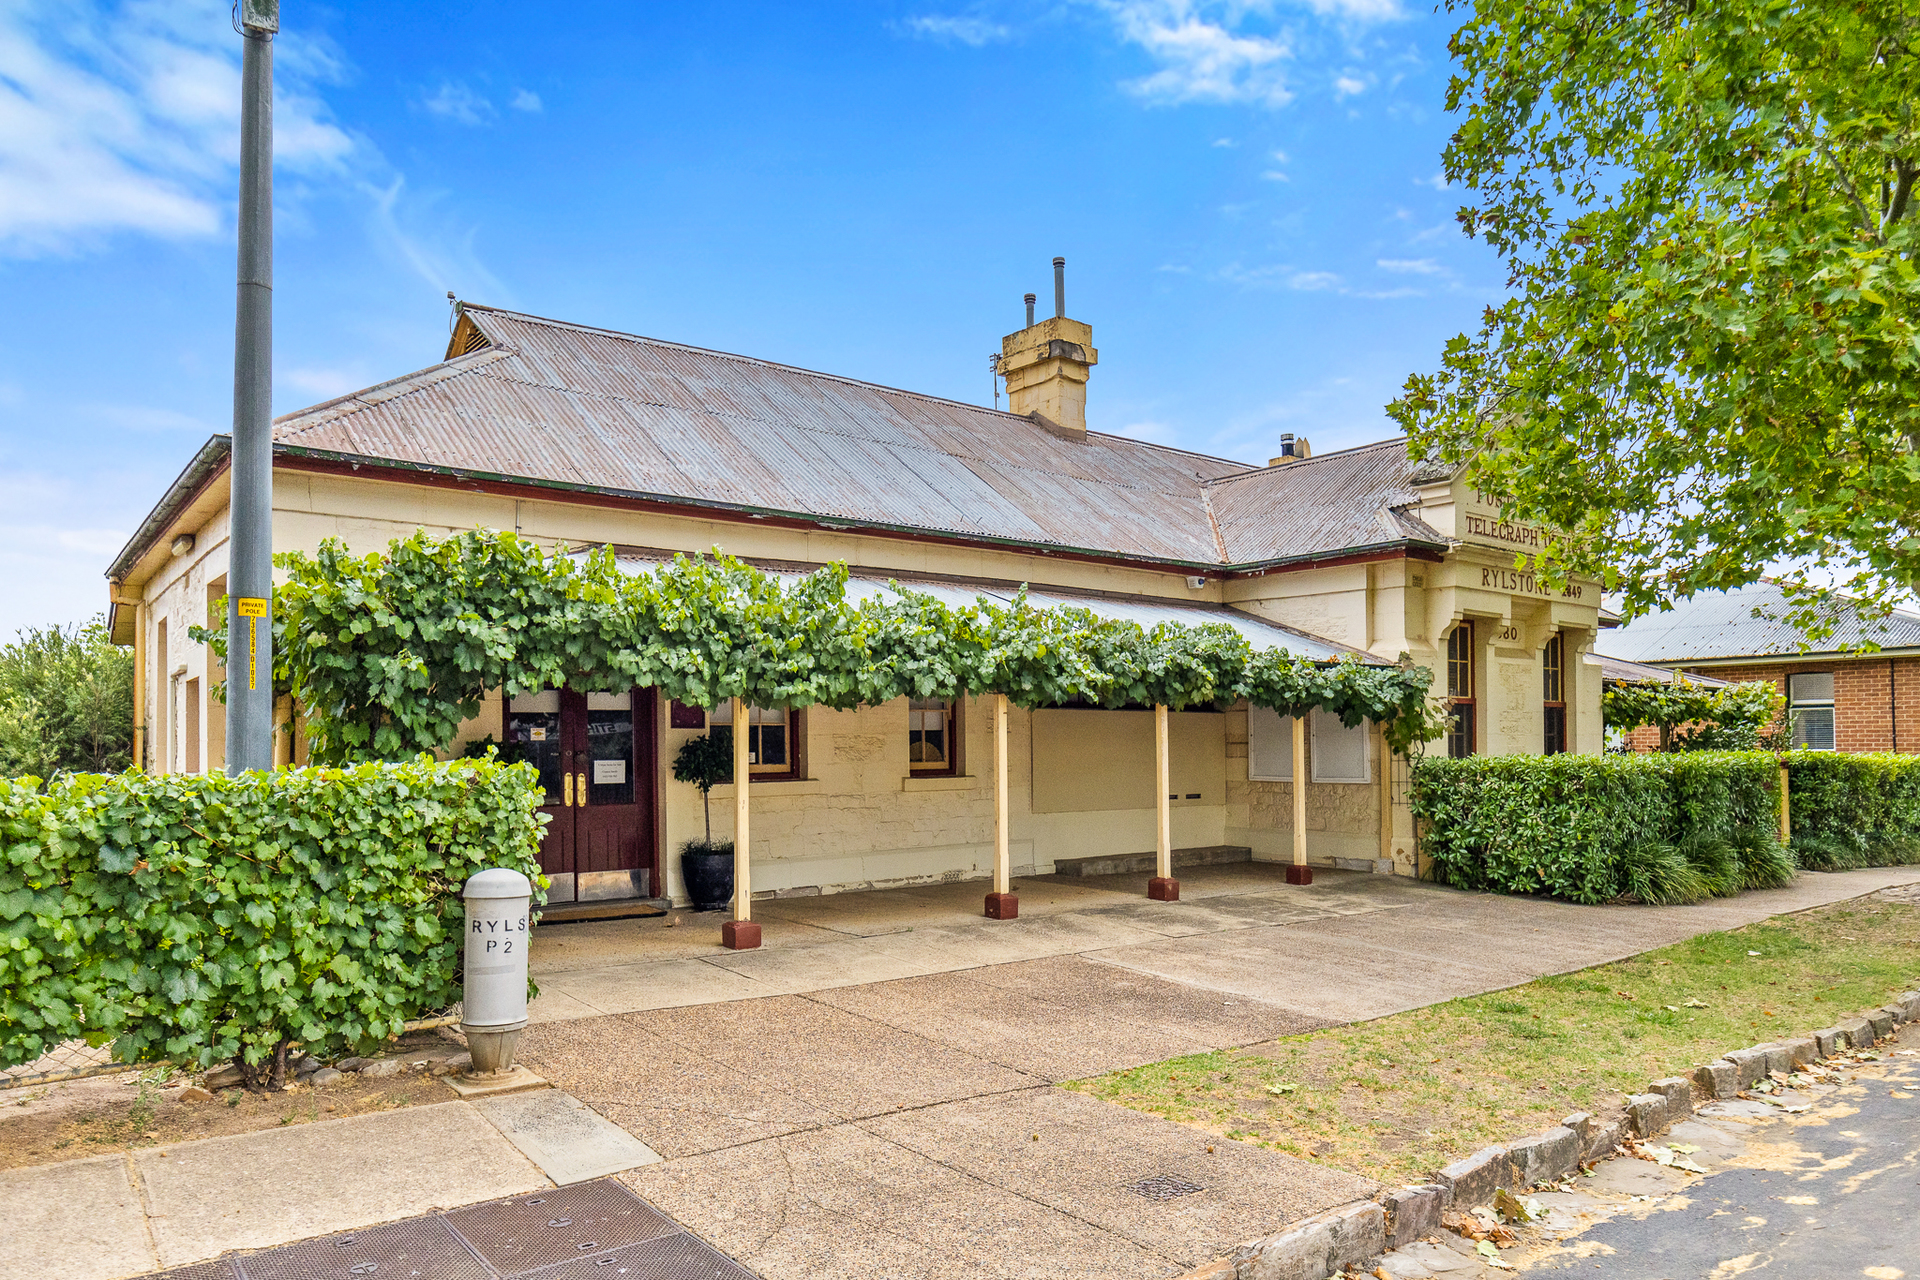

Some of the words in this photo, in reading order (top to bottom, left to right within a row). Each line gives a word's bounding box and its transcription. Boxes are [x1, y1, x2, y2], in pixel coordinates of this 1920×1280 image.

[1465, 515, 1539, 547] TELEGRAPH
[241, 601, 264, 609] PRIVATE
[1498, 626, 1518, 641] 80
[472, 917, 526, 934] RYLS
[486, 939, 513, 954] P2
